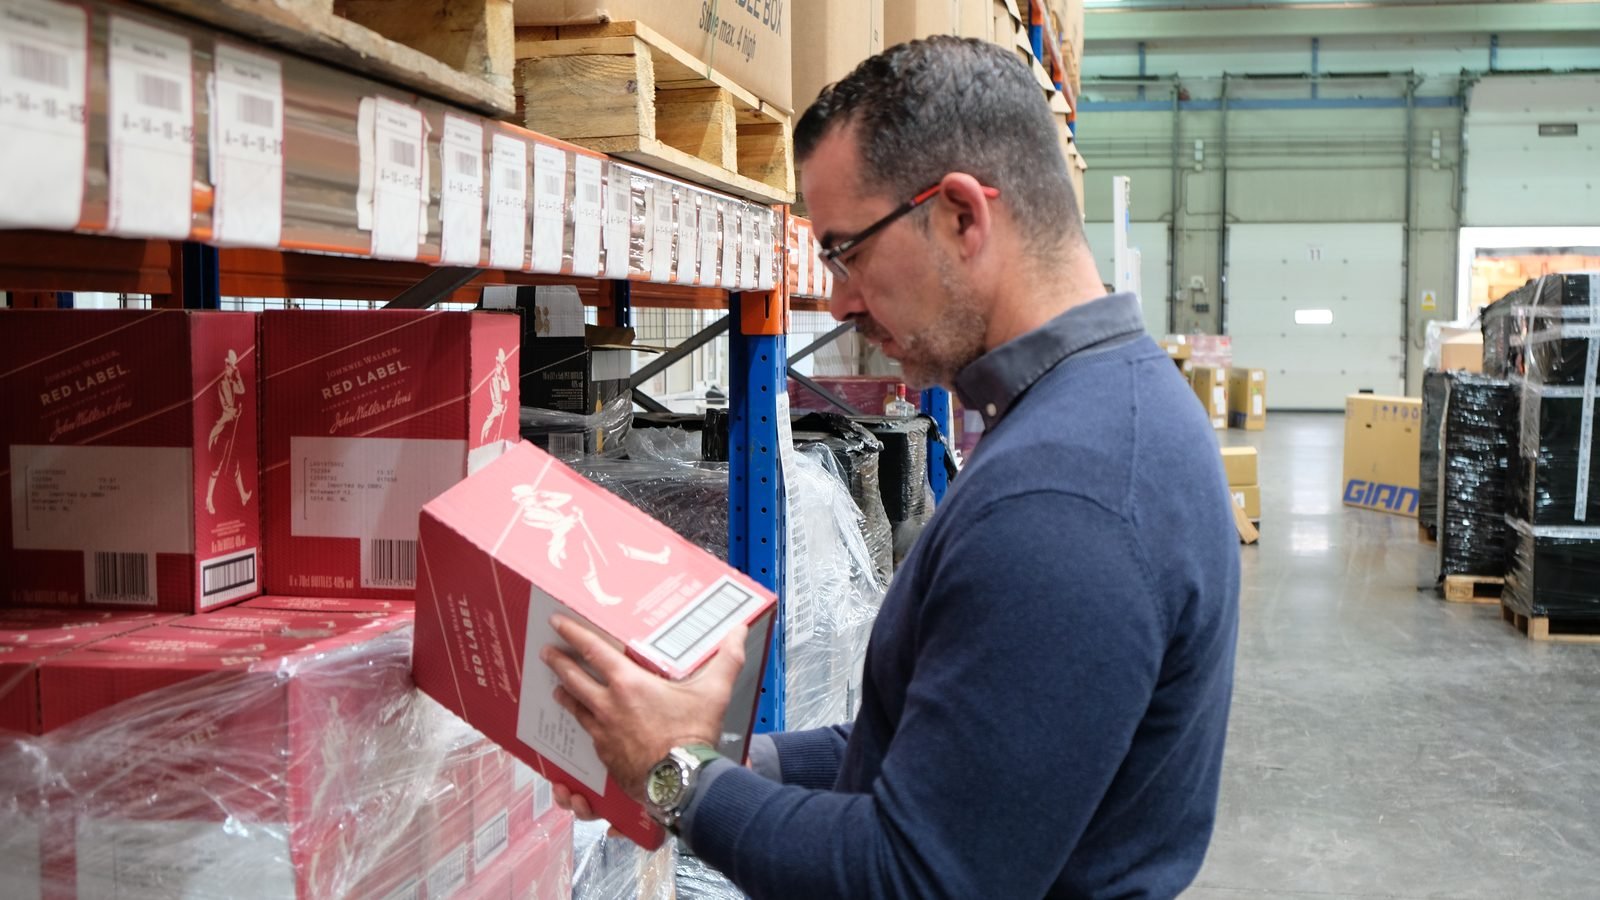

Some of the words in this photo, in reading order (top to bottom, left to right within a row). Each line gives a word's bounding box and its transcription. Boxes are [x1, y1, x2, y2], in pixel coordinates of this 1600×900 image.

[1309, 248, 1321, 262] 11
[40, 385, 72, 406] RED
[75, 363, 127, 392] LABEL
[321, 379, 353, 400] RED
[356, 360, 408, 386] LABEL
[1343, 479, 1420, 511] GIAN
[458, 593, 479, 650] LABEL
[471, 654, 488, 687] RED
